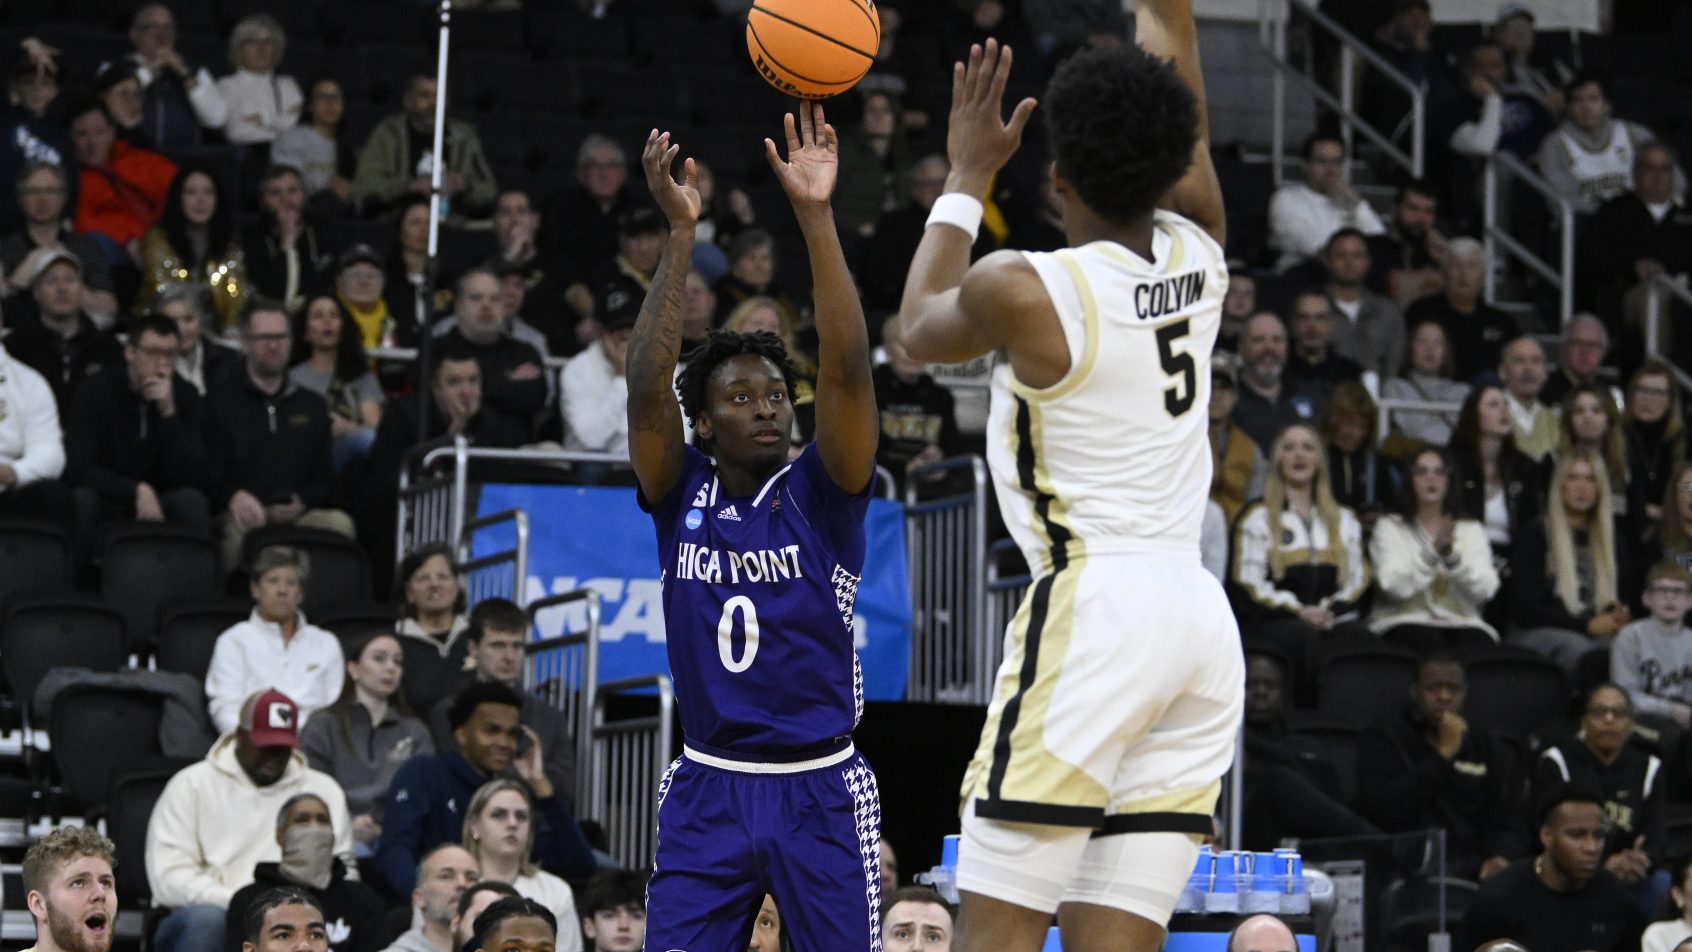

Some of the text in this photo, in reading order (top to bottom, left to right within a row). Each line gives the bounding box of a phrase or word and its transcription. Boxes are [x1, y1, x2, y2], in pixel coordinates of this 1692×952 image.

[1154, 317, 1196, 418] 5
[717, 513, 741, 522] adidas
[727, 545, 803, 583] POINT
[717, 595, 760, 673] 0
